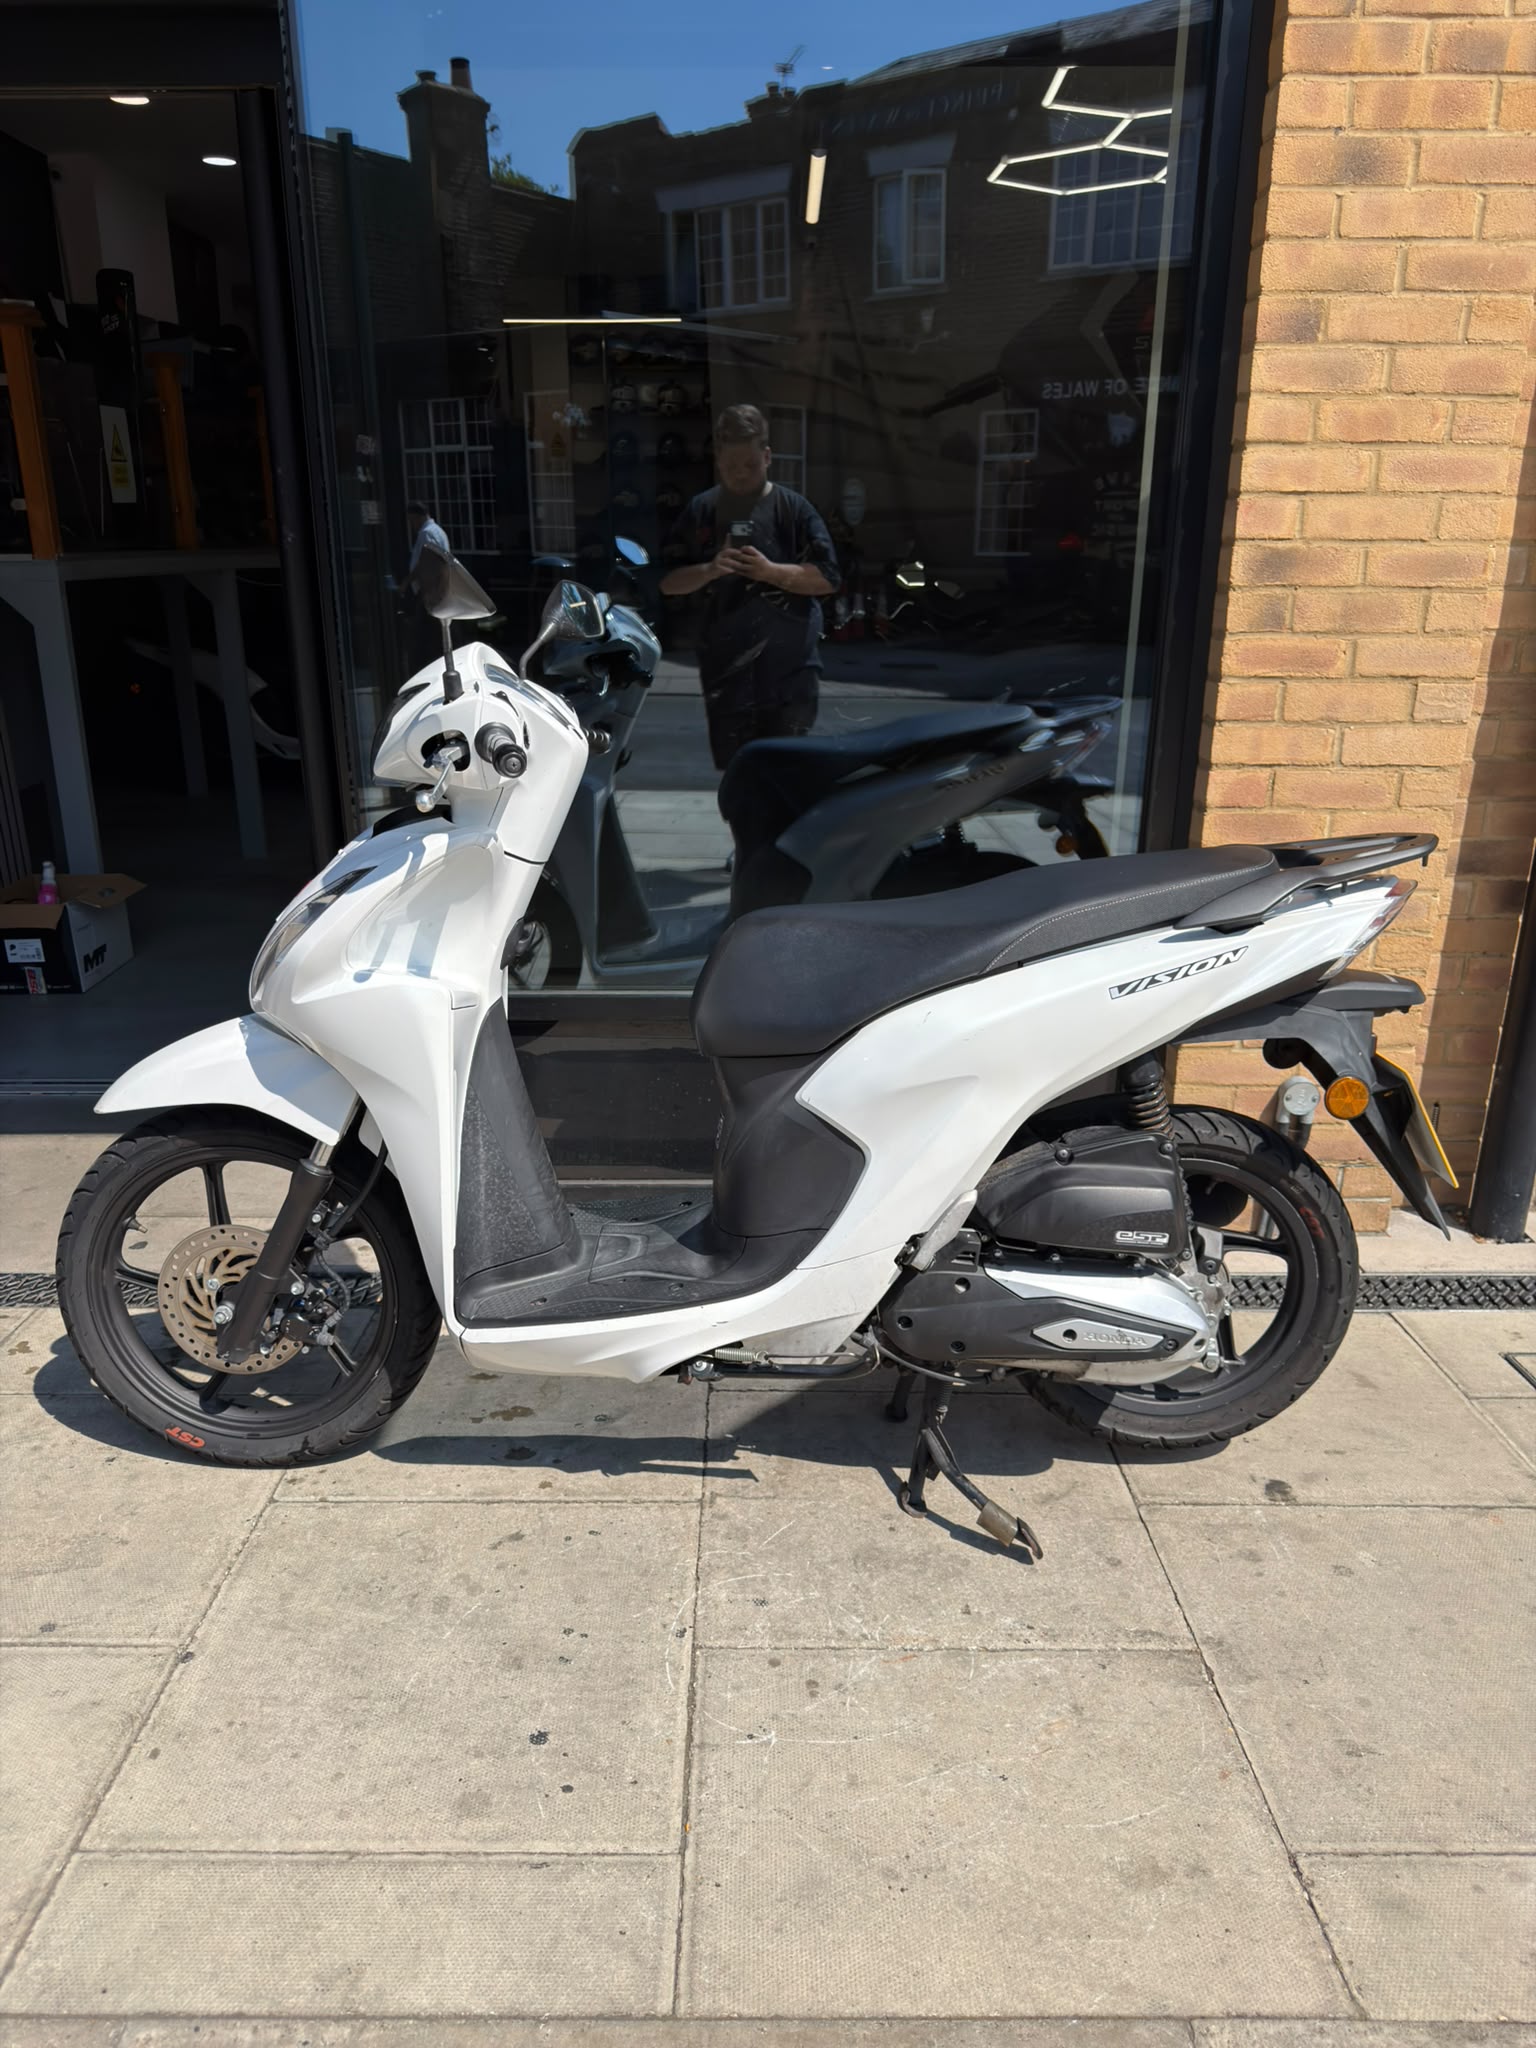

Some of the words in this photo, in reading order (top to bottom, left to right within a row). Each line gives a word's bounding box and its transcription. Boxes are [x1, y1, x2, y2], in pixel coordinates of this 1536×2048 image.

[83, 944, 107, 973] MT
[1109, 946, 1248, 999] VISION
[1083, 1331, 1148, 1347] HONDA
[164, 1425, 206, 1448] CST
